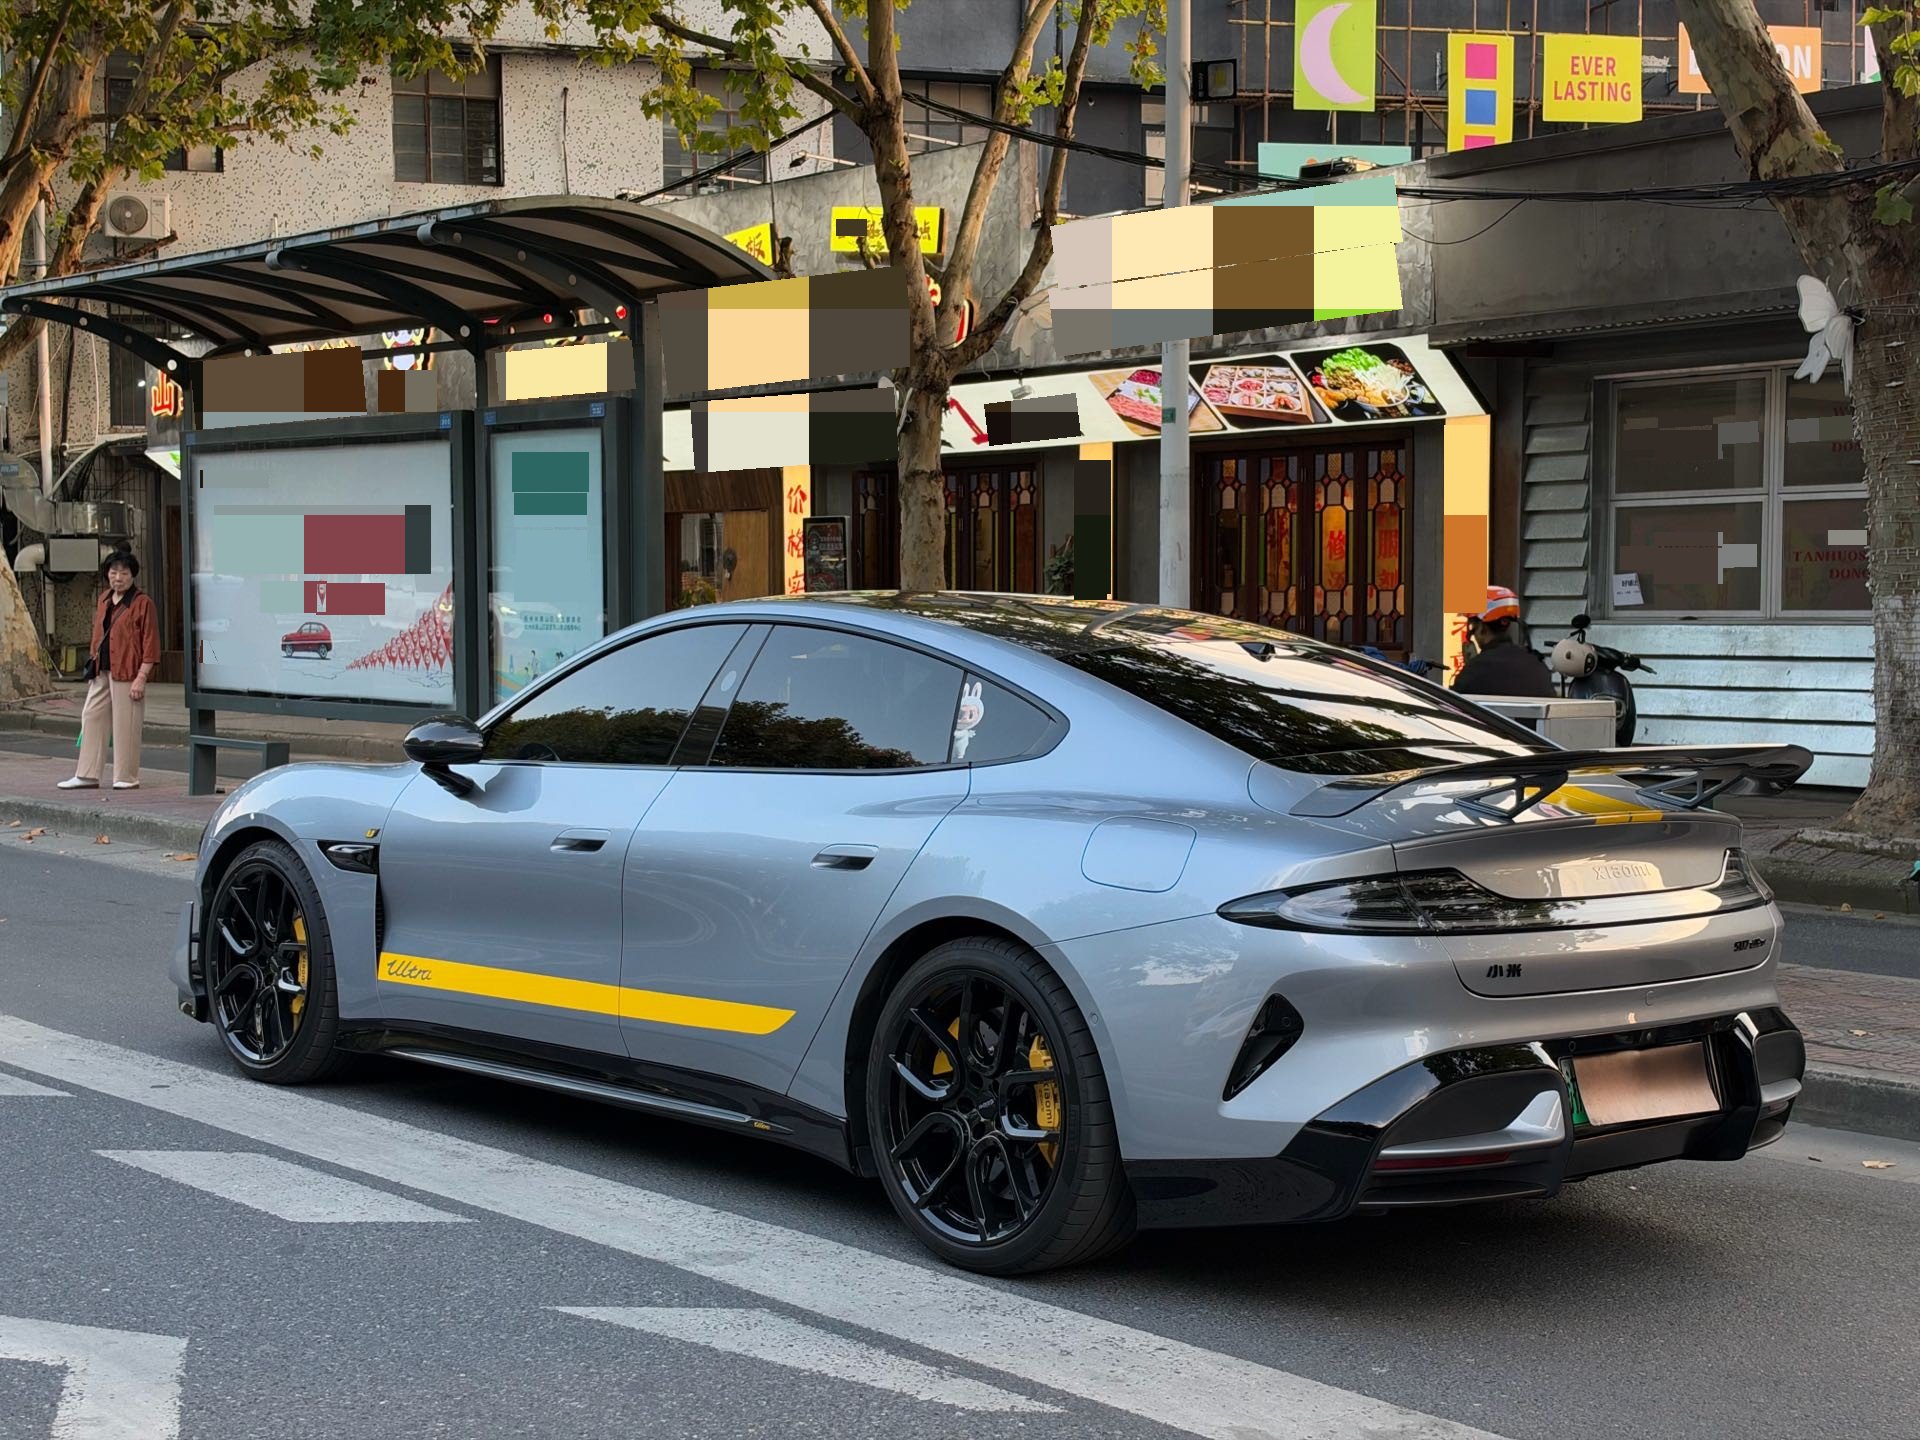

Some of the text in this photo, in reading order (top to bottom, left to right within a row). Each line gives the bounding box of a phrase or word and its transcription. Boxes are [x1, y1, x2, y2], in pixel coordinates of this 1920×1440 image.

[1570, 56, 1616, 77] EVER
[1553, 81, 1632, 102] LASTING
[387, 959, 433, 981] Ultra
[1486, 963, 1522, 978] 小米
